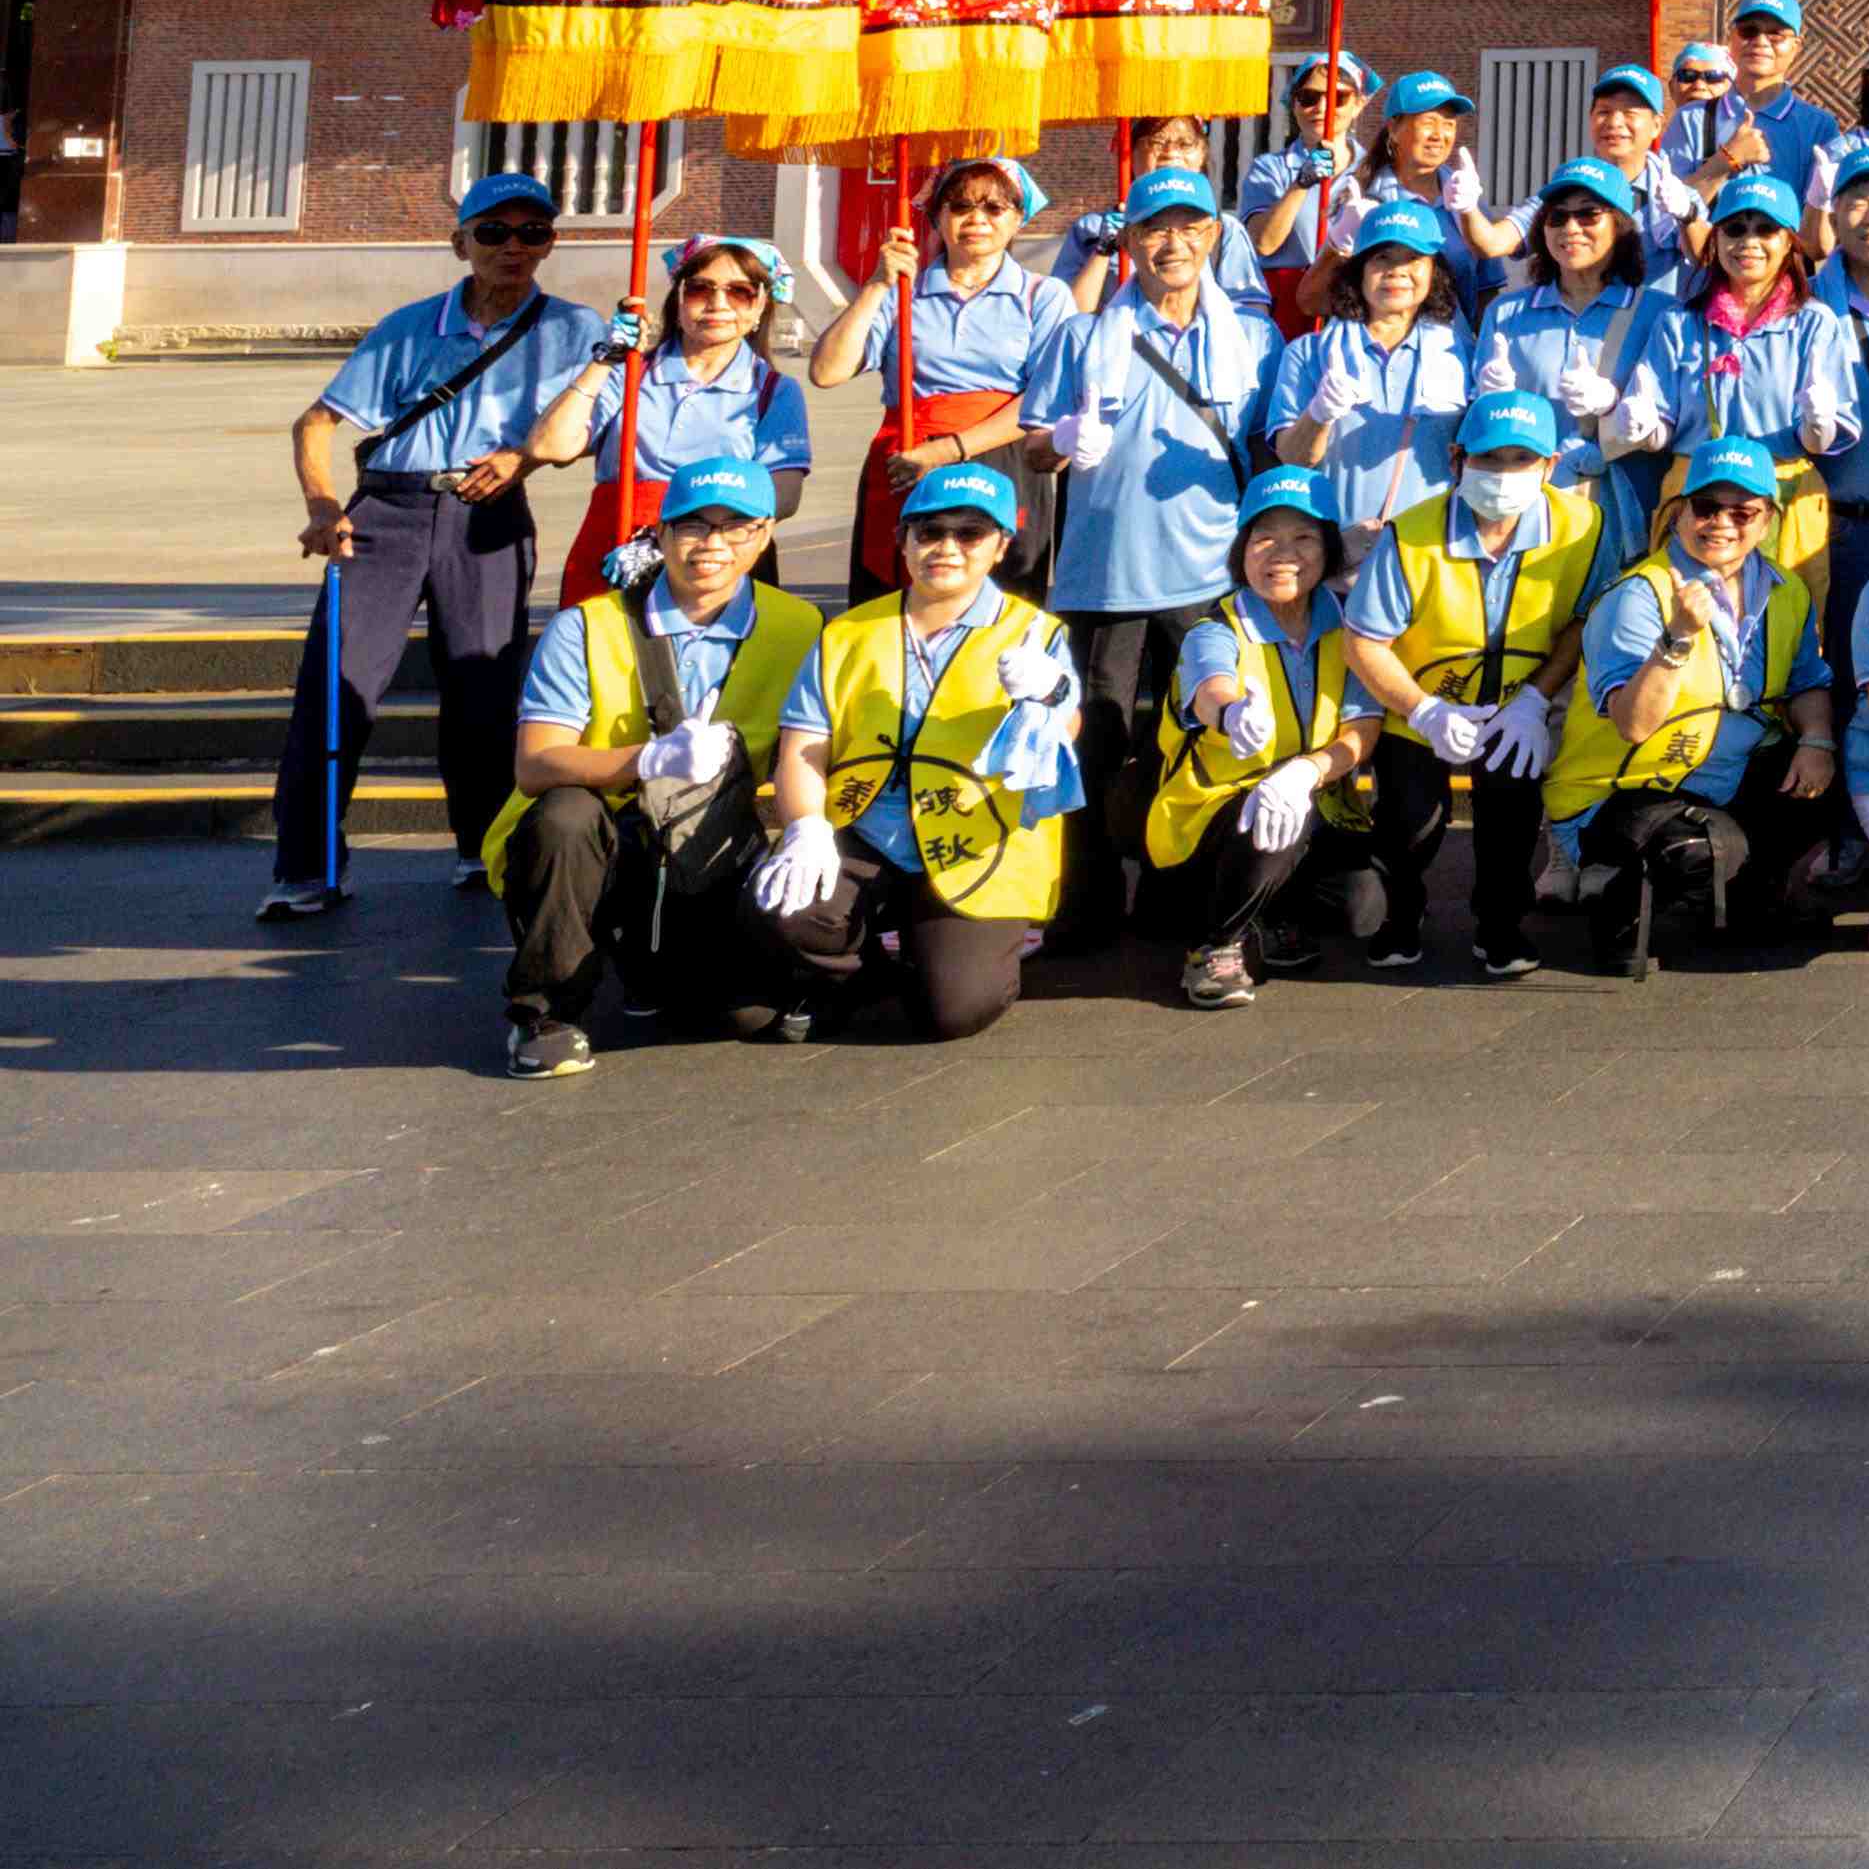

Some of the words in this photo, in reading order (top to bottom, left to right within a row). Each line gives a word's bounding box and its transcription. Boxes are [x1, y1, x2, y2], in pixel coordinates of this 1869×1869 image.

[1564, 164, 1605, 180] HAKKA
[1149, 179, 1195, 194] HAKKA
[1736, 185, 1777, 201] HAKKA
[1375, 213, 1418, 228] HAKKA
[1490, 408, 1536, 425] HAKKA
[1708, 450, 1753, 466] HAKKA
[690, 472, 746, 490] HAKKA
[944, 476, 995, 496] HAKKA
[1262, 480, 1310, 495] HAKKA
